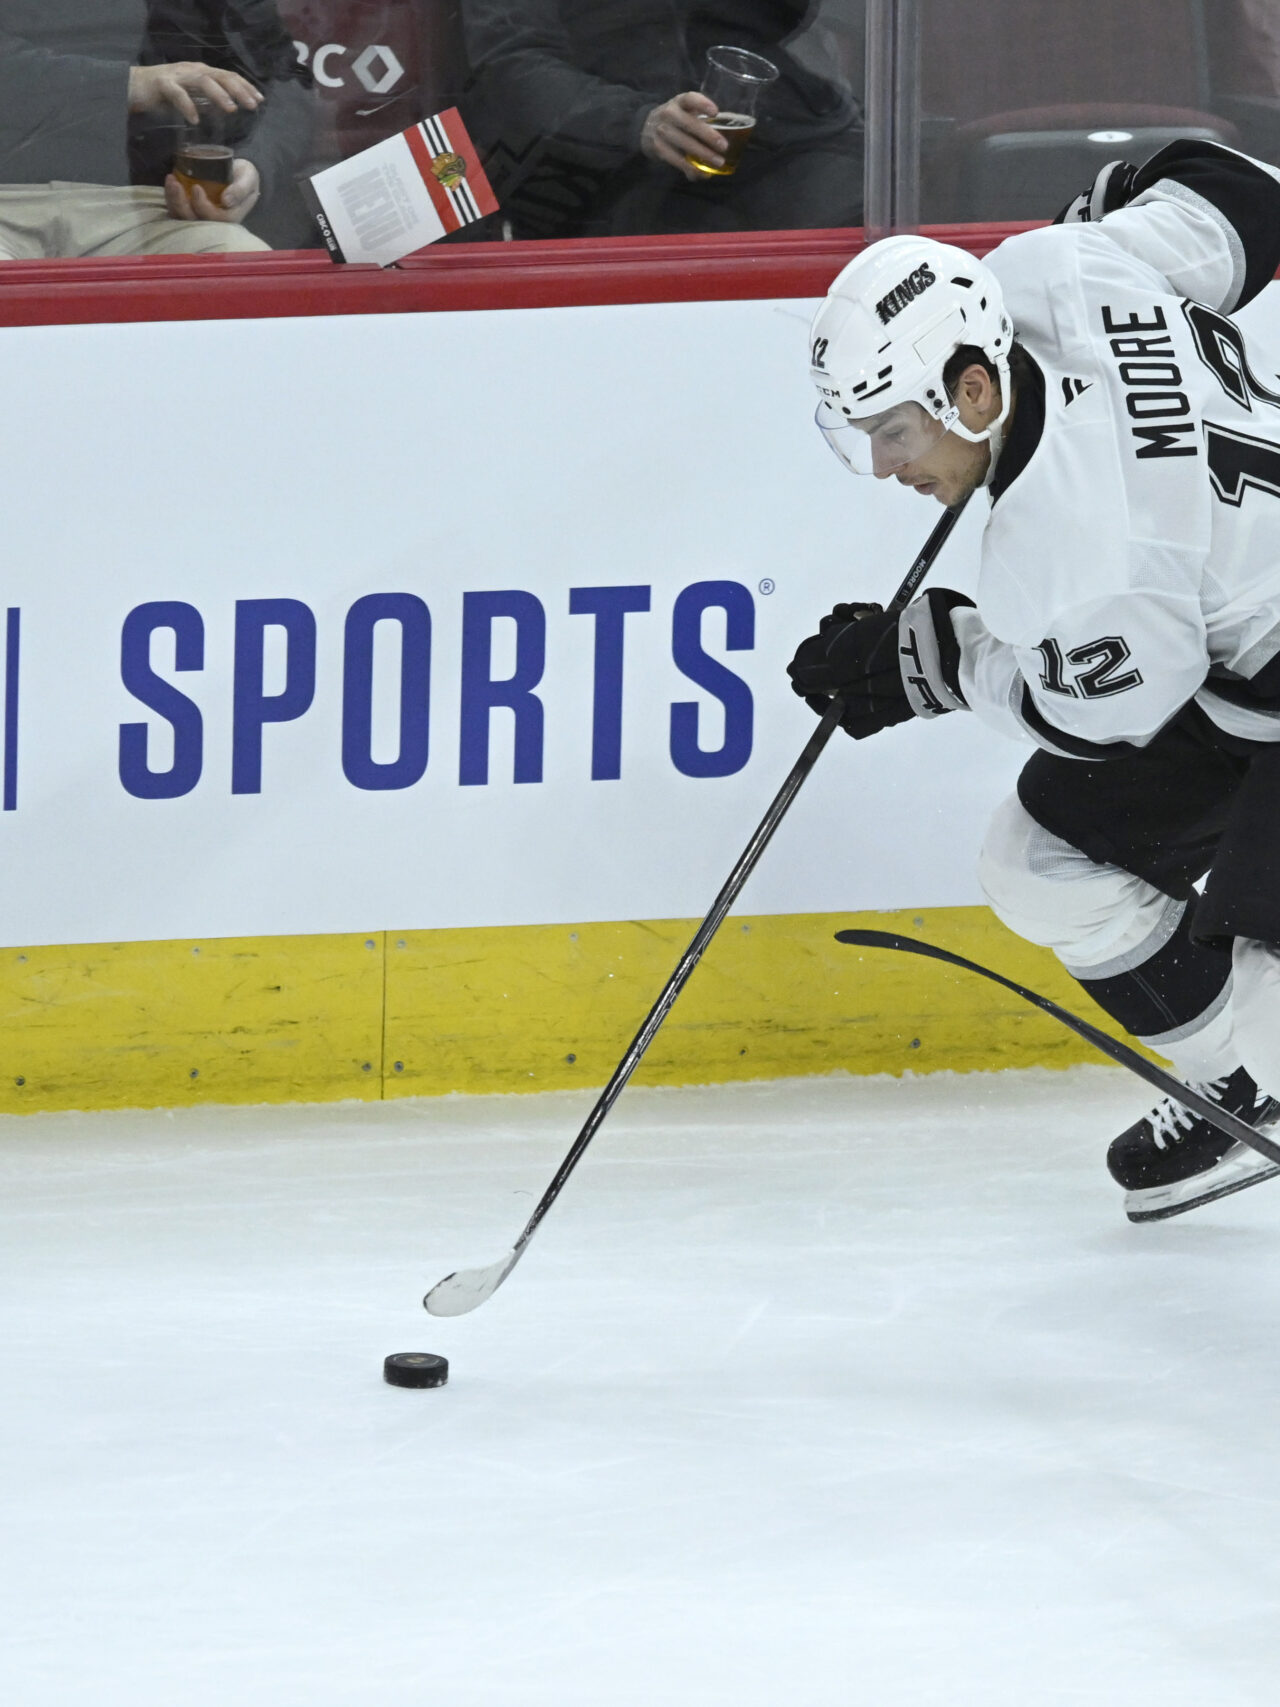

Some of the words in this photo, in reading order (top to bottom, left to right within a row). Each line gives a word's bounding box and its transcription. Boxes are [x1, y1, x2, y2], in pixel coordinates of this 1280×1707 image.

[875, 261, 937, 326] KINGS
[811, 336, 829, 369] 12
[1101, 304, 1199, 460] MOORE
[906, 557, 927, 588] MOORE
[1030, 635, 1144, 701] 12
